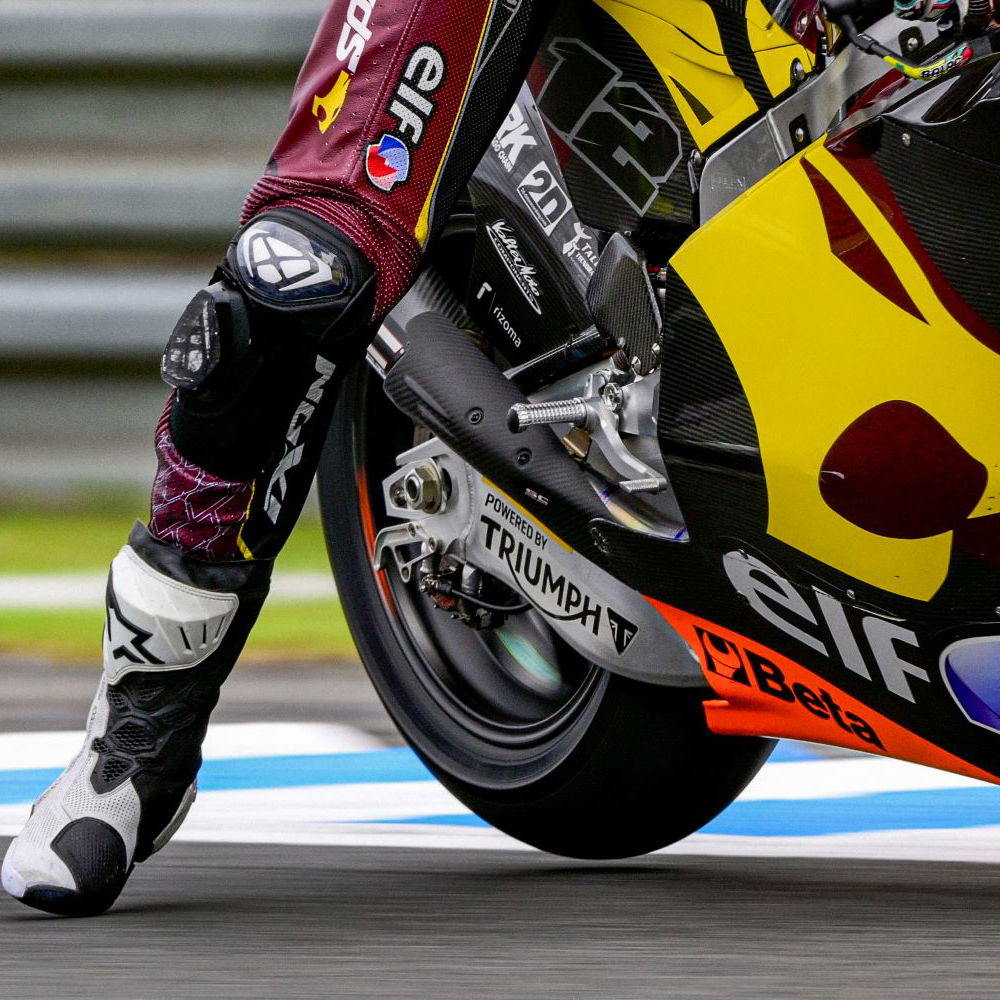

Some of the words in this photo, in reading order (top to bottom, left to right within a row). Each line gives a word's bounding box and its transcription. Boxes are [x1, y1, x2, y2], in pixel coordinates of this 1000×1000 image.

[397, 44, 446, 146] elf
[540, 37, 683, 217] 12
[493, 306, 522, 348] rizoma
[484, 492, 533, 540] POWERED
[534, 532, 548, 550] BY
[525, 487, 549, 506] SC
[480, 514, 602, 637] TRIUMPH
[721, 549, 932, 704] elf
[756, 644, 886, 752] Beta
